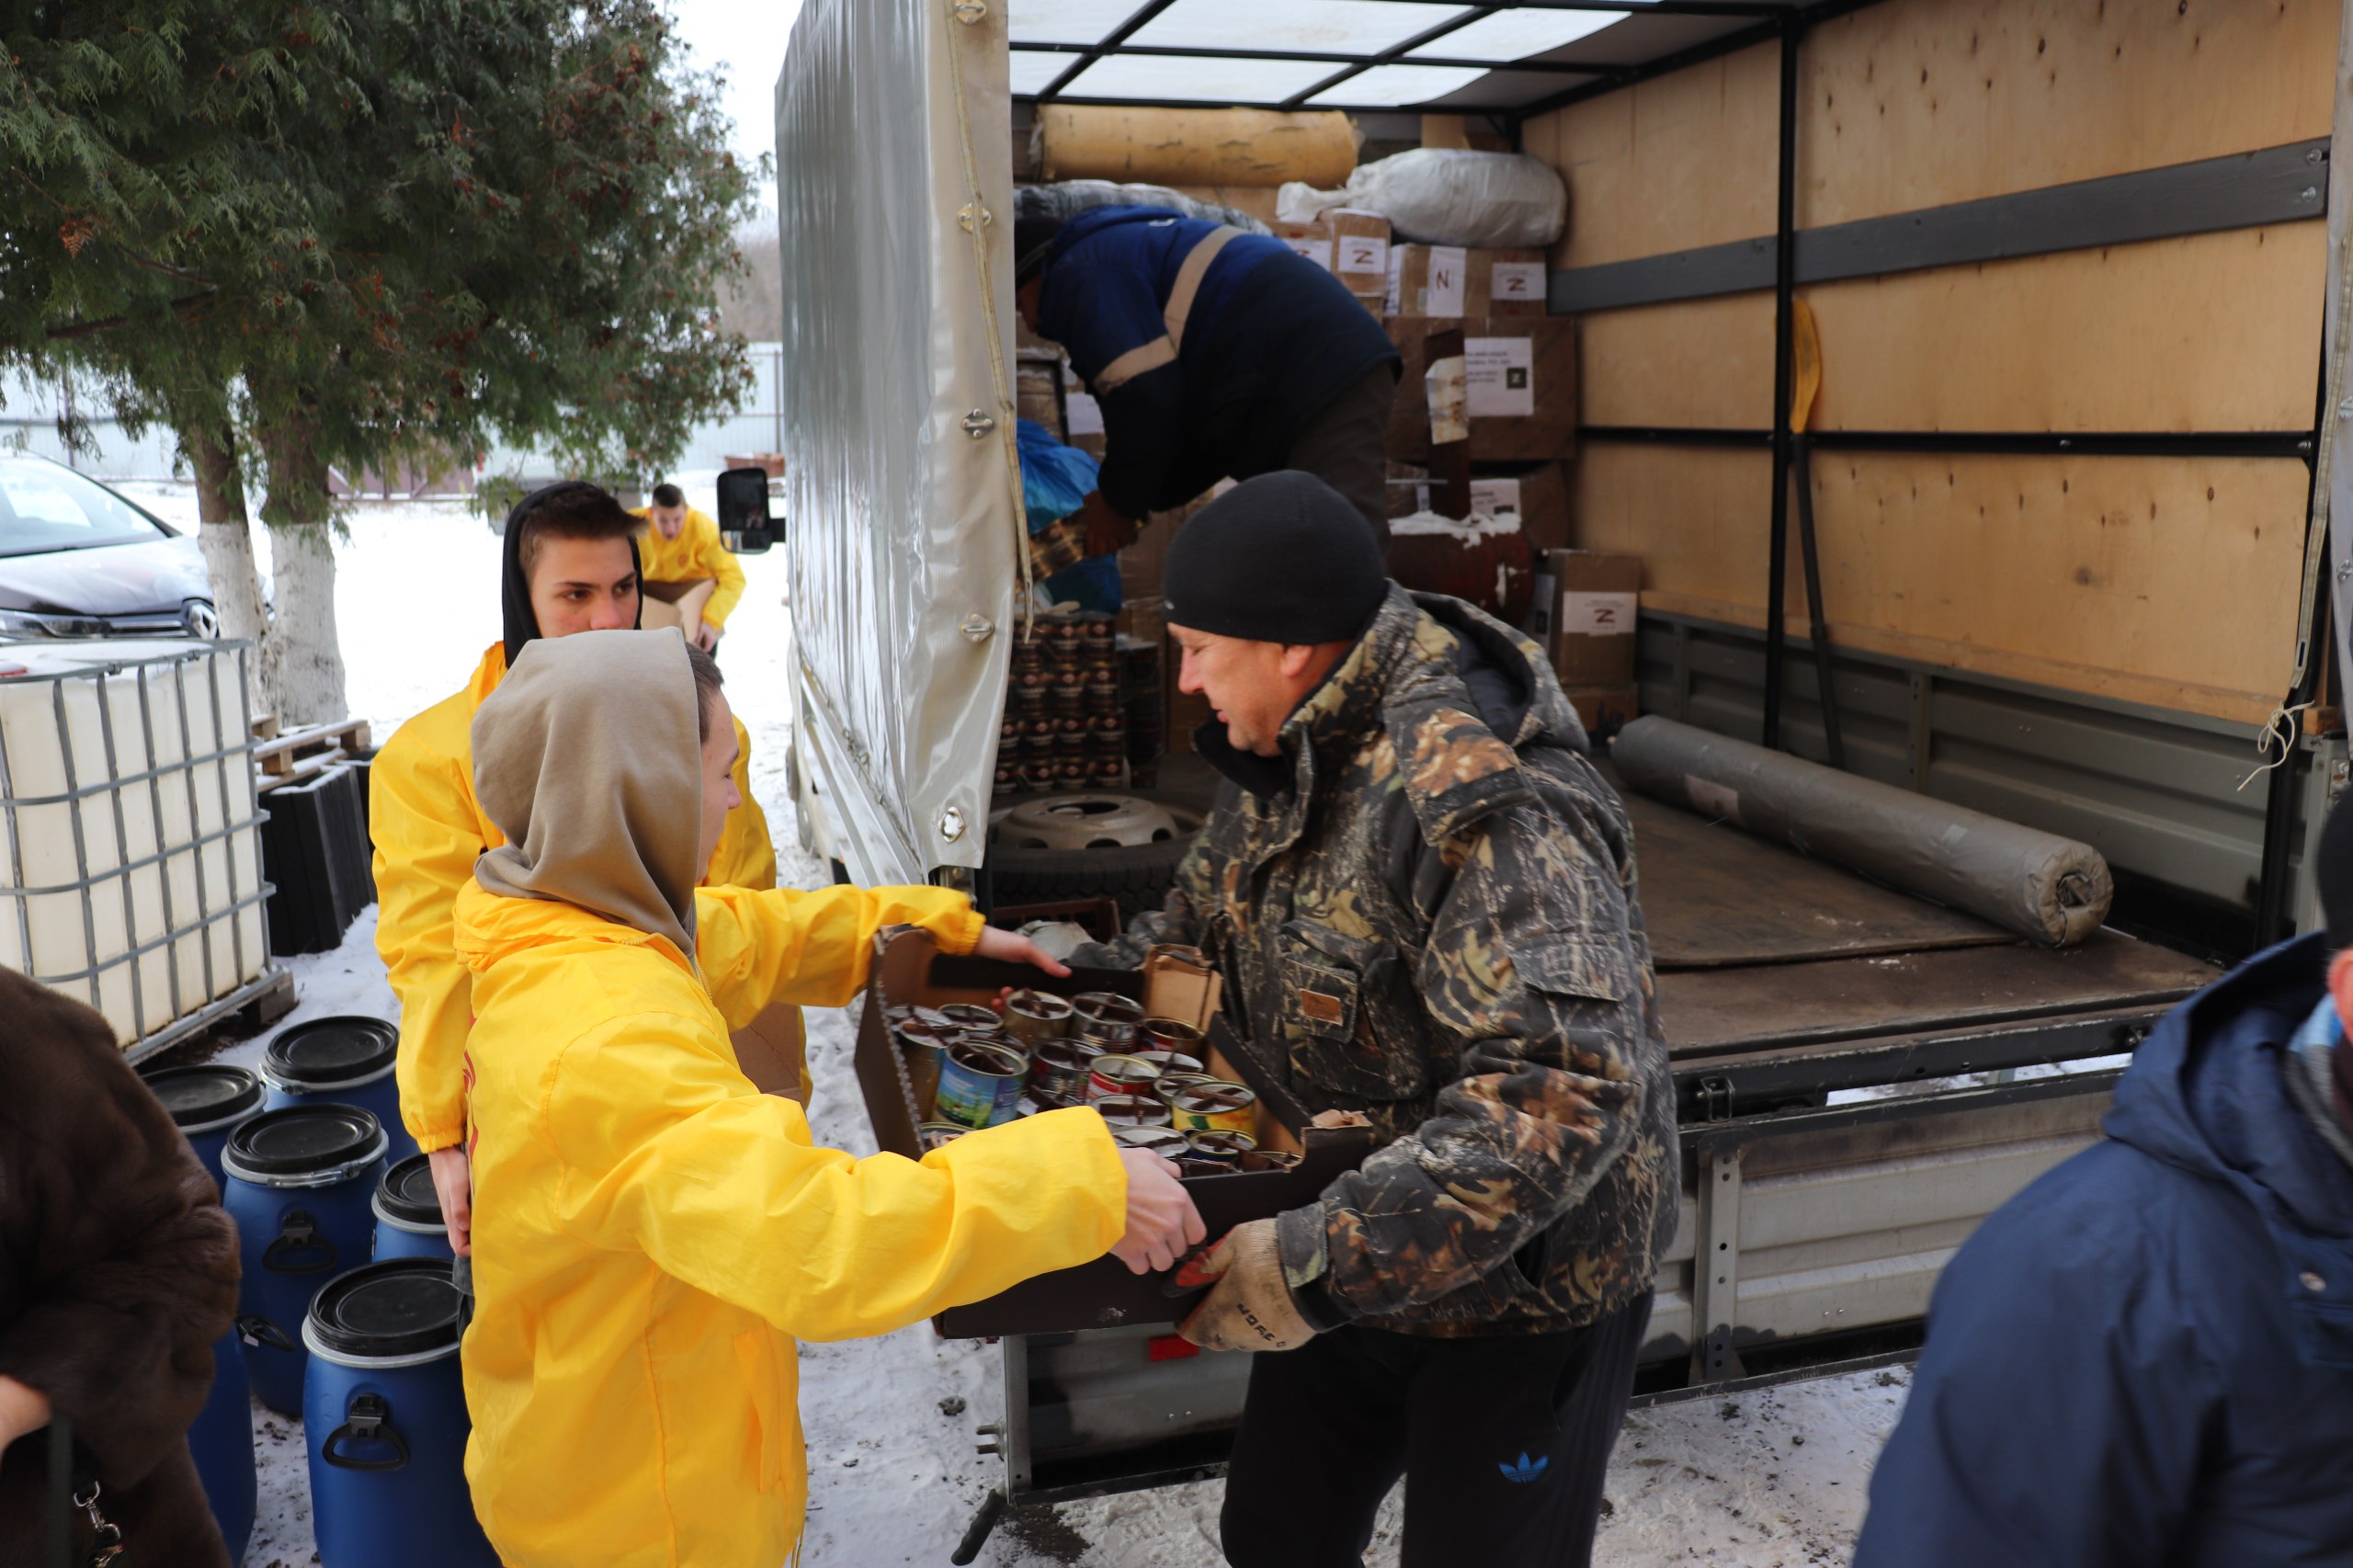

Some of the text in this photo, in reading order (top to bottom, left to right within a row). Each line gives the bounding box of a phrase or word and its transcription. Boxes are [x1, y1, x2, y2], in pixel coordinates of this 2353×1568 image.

[1353, 249, 1374, 265] Z
[1506, 278, 1526, 292] Z
[1594, 608, 1616, 624] Z
